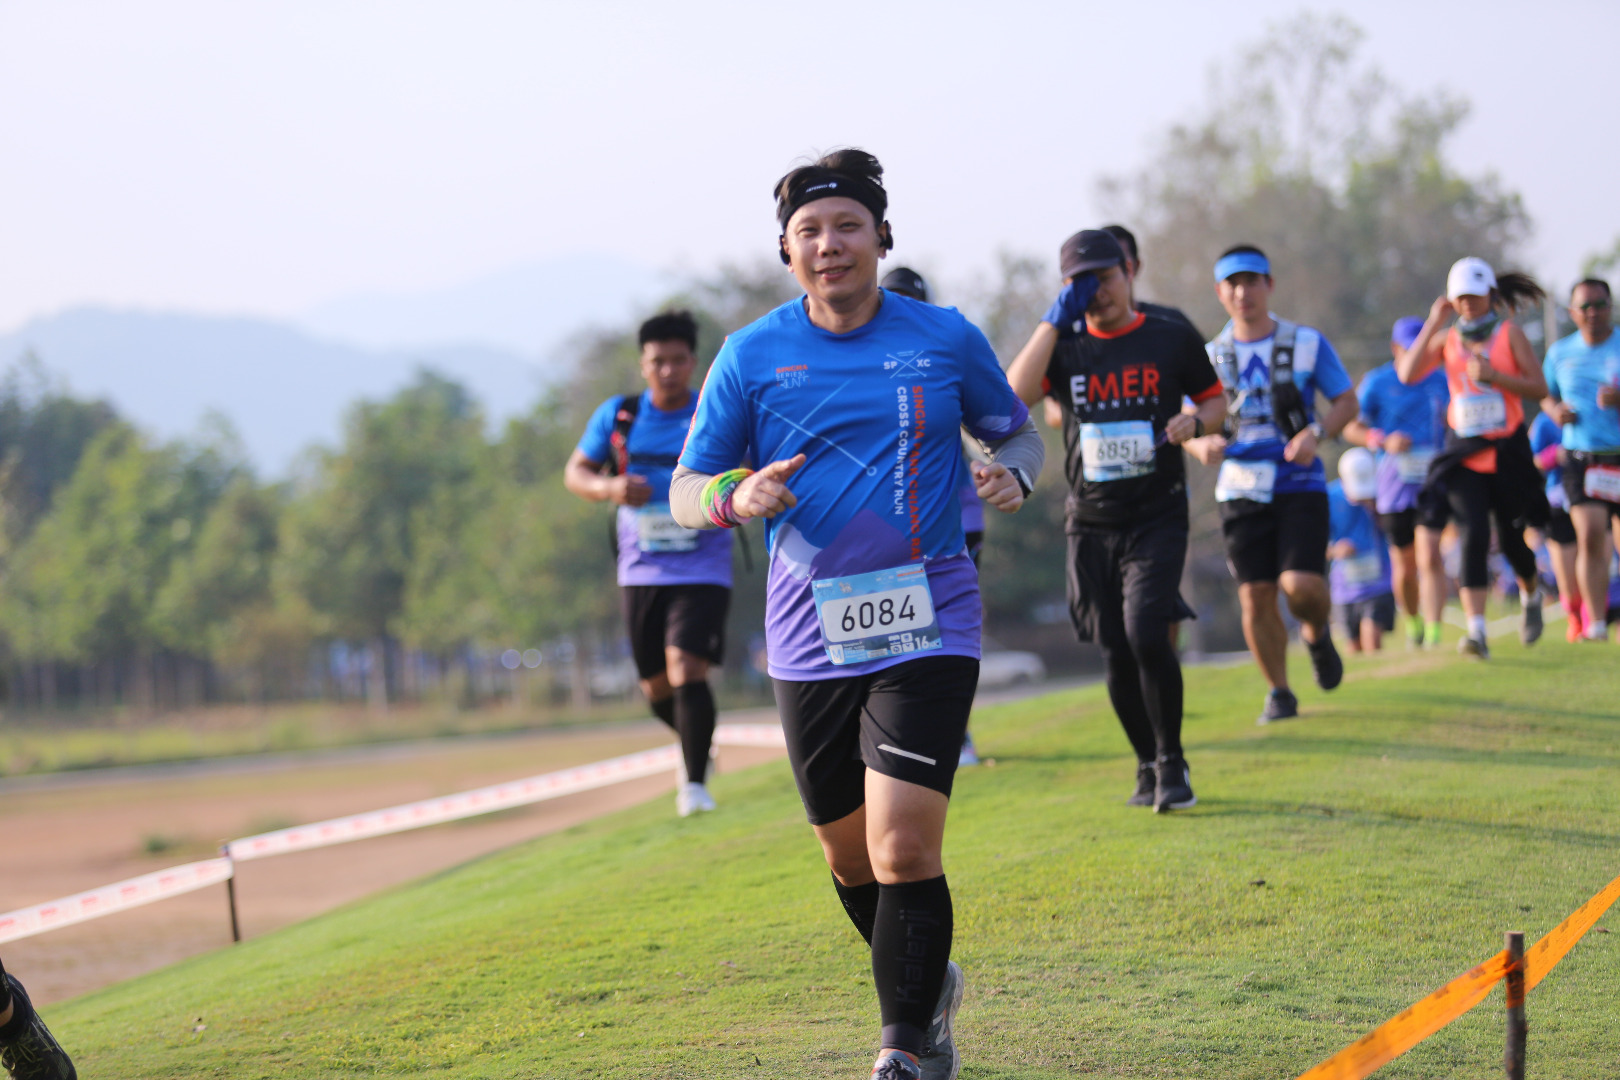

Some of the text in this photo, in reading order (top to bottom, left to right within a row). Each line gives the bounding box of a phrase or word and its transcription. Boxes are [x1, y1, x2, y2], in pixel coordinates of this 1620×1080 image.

[916, 358, 931, 367] XC
[1070, 368, 1160, 405] EMER
[897, 386, 909, 428] CROSS
[912, 385, 926, 440] SINGHA
[894, 430, 909, 487] COUNTRY
[909, 442, 922, 477] PARK
[894, 489, 904, 515] RUN
[908, 479, 920, 535] CHIANG
[911, 537, 921, 560] RAI
[841, 594, 916, 632] 6084
[915, 635, 930, 650] 16
